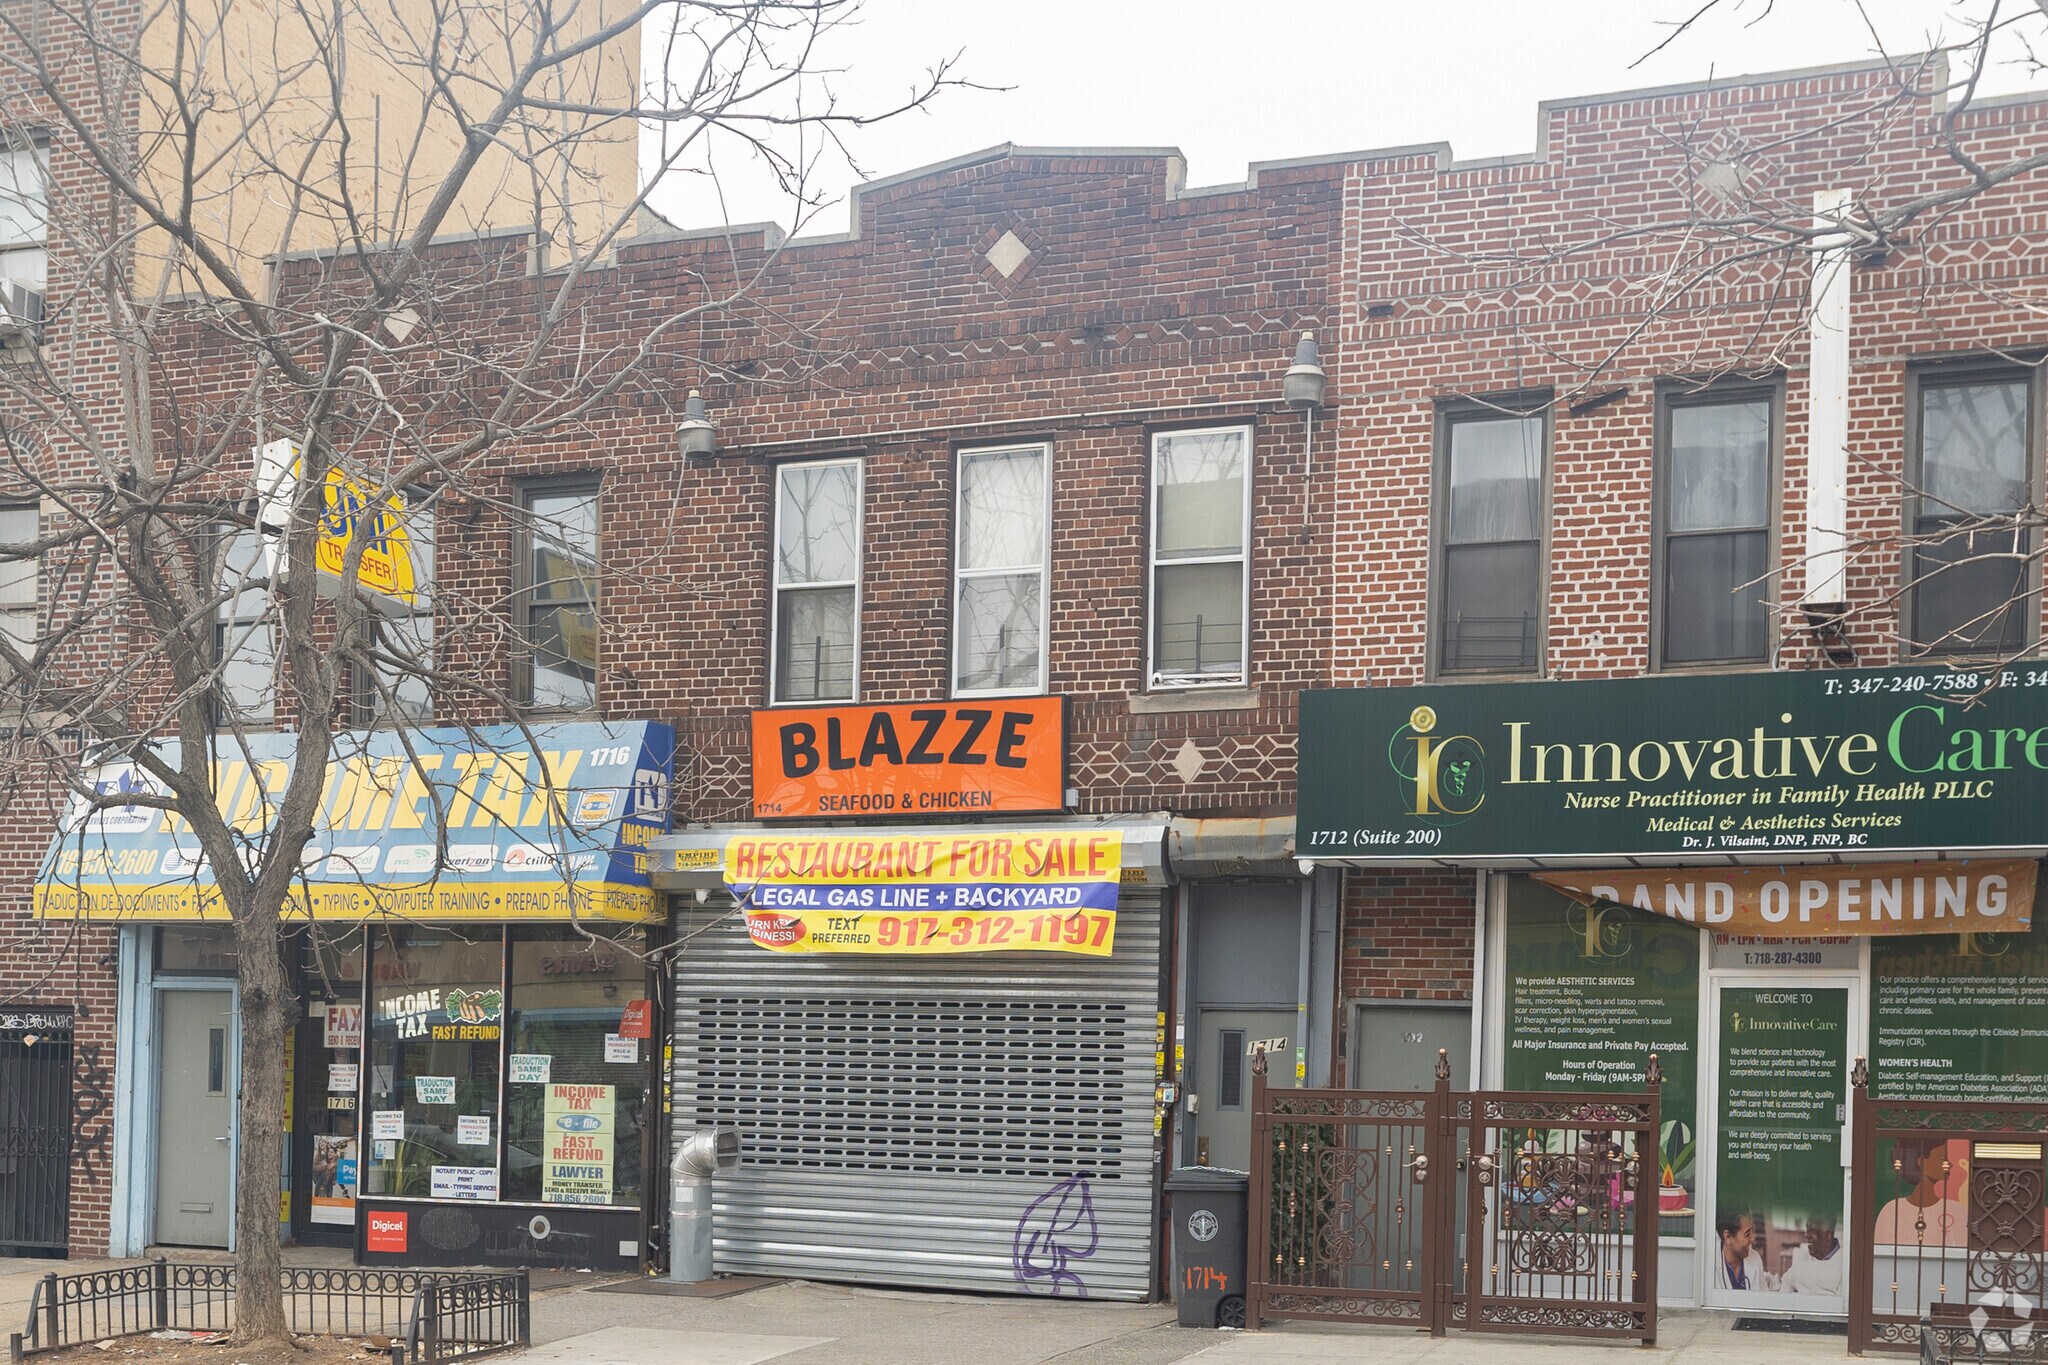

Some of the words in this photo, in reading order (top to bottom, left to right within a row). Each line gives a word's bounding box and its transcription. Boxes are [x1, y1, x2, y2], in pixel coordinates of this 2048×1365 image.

[326, 540, 391, 580] TRSFER
[1824, 679, 1843, 695] T:
[1848, 675, 1979, 694] 347-240-7588
[779, 709, 1035, 778] BLAZZE
[1501, 712, 1878, 784] Innovative
[1887, 705, 2048, 774] Care
[590, 746, 630, 767] 1716
[446, 749, 583, 828] TAX
[1564, 791, 1620, 809] Nurse
[1626, 788, 1746, 808] Practitioner
[1752, 787, 1772, 804] in
[1778, 784, 1849, 807] Family
[1855, 781, 1926, 802] Health
[1932, 780, 1994, 800] PLLC
[819, 793, 896, 812] SEAFOOD
[901, 793, 913, 809] &
[919, 790, 993, 809] CHICKEN
[757, 803, 783, 814] 1714
[1646, 815, 1714, 833] Medical
[1719, 815, 1735, 830] &
[1741, 813, 1826, 831] Aesthetics
[1831, 811, 1902, 828] Services
[1310, 830, 1348, 845] 1712
[1353, 828, 1400, 847] (Suite
[1405, 828, 1442, 847] 200)
[1682, 836, 1703, 848] Dr.
[1706, 835, 1716, 848] J.
[1720, 834, 1769, 848] Vilsaint,
[1774, 834, 1807, 847] DNP,
[1812, 833, 1843, 847] FNP,
[1848, 833, 1868, 845] BC
[448, 857, 490, 868] verizon
[737, 840, 944, 880] RESTAURANT
[949, 839, 1012, 878] FOR
[1023, 837, 1108, 878] SALE
[102, 892, 115, 911] DE
[117, 892, 180, 911] DOCUMENTS
[323, 893, 359, 911] TYPING
[376, 891, 435, 911] COMPUTER
[440, 891, 490, 910] TRAINING
[506, 892, 550, 911] PREPAID
[554, 890, 593, 910] PHONE
[752, 888, 821, 906] LEGAL
[827, 888, 874, 907] GAS
[880, 888, 930, 907] LINE
[954, 886, 1082, 906] BACKYARD
[1760, 874, 2008, 923] OPENING
[750, 928, 796, 942] SINESS!
[827, 917, 860, 931] TEXT
[878, 915, 1110, 947] 917-312-1197
[812, 932, 871, 945] PREFERRED
[1716, 934, 1729, 945] RN
[1744, 952, 1753, 964] T:
[1754, 952, 1822, 964] 718-287-4300
[1515, 977, 1528, 986] We
[1528, 977, 1556, 987] provide
[1556, 977, 1598, 986] AESTHETIC
[1598, 977, 1635, 986] SERVICES
[1894, 976, 1919, 985] practice
[1529, 988, 1562, 996] treatment,
[1563, 988, 1584, 996] Botox,
[1879, 986, 1909, 995] including
[1910, 986, 1935, 995] primary
[378, 988, 441, 1021] INCOME
[1755, 993, 1798, 1004] WELCOME
[1800, 993, 1813, 1004] TO
[1577, 1007, 1638, 1016] hyperpigmentation,
[1879, 1006, 1903, 1015] chronic
[1904, 1006, 1934, 1015] diseases.
[328, 1008, 361, 1031] FAX
[396, 1013, 430, 1039] TAX
[431, 1025, 458, 1040] FAST
[459, 1025, 500, 1040] REFUND
[1879, 1027, 1923, 1036] Immunization
[1924, 1028, 1951, 1036] services
[1952, 1028, 1979, 1037] through
[1512, 1040, 1523, 1049] All
[1524, 1040, 1547, 1050] Major
[1547, 1040, 1586, 1050] Insurance
[1588, 1041, 1603, 1050] and
[1604, 1041, 1633, 1051] Private
[1634, 1042, 1649, 1052] Pay
[1650, 1042, 1689, 1052] Accepted.
[1878, 1038, 1905, 1047] Registry
[1906, 1038, 1927, 1047] (CIR).
[511, 1056, 549, 1066] TRADUCTION
[1562, 1060, 1586, 1069] Hours
[1587, 1060, 1596, 1069] of
[1597, 1060, 1636, 1070] Operation
[1737, 1058, 1759, 1067] provide
[1771, 1059, 1795, 1067] patients
[1878, 1058, 1919, 1067] WOMEN'S
[1920, 1058, 1953, 1067] HEALTH
[416, 1078, 453, 1088] TRADUCTION
[518, 1073, 541, 1081] DAY
[1545, 1072, 1576, 1082] Monday
[1582, 1073, 1607, 1083] Friday
[553, 1086, 606, 1099] INCOME
[329, 1098, 354, 1109] 1716
[567, 1098, 592, 1110] TAX
[562, 1135, 595, 1148] FAST
[553, 1148, 604, 1161] REFUND
[552, 1166, 604, 1179] LAWYER
[372, 1220, 403, 1232] Digicel
[1186, 1266, 1228, 1292] 1714
